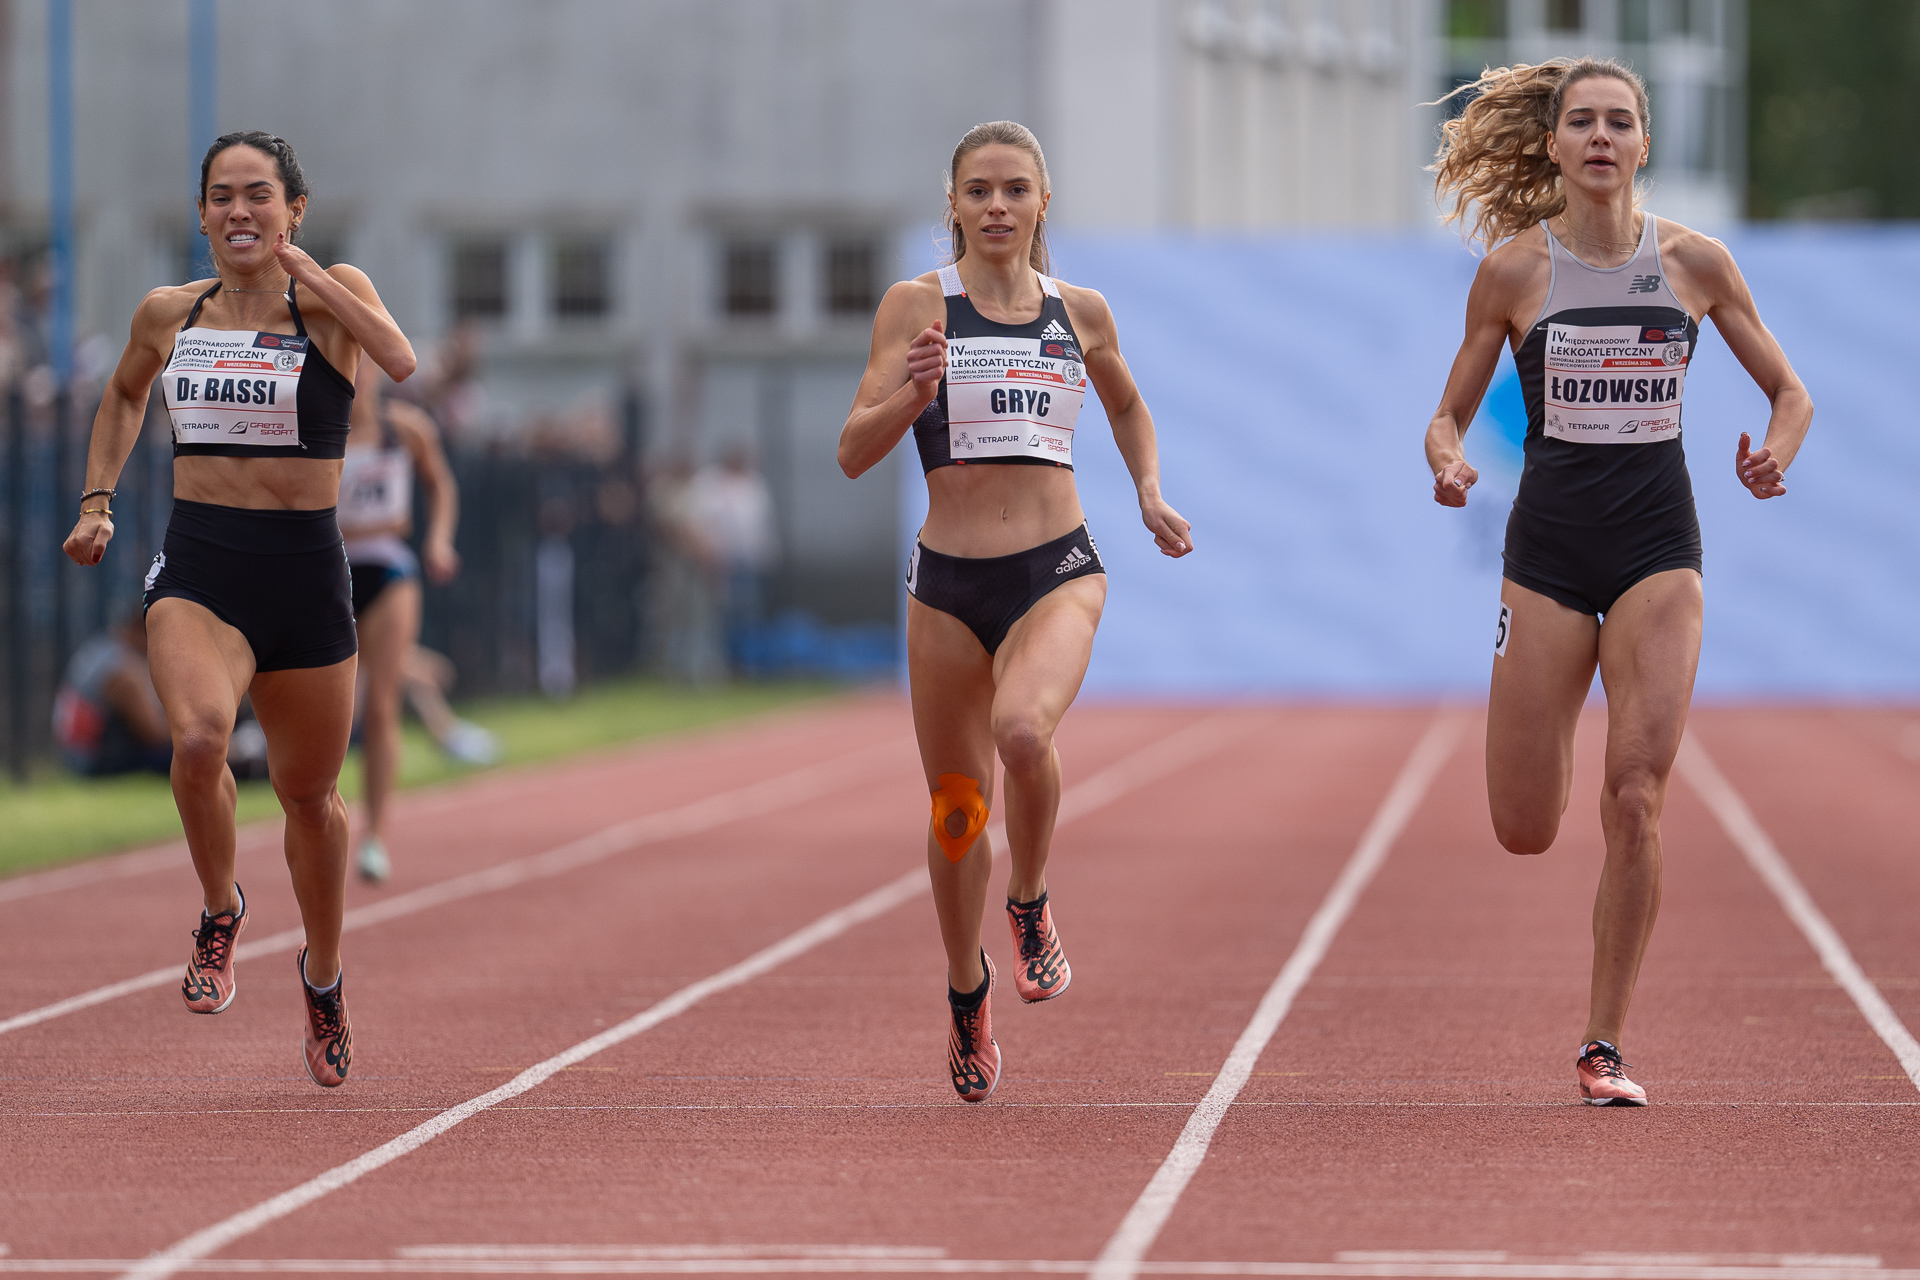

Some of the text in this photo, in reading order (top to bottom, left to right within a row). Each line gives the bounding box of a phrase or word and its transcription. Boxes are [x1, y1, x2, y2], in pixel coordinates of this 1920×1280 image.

[1041, 332, 1073, 341] adidas
[1552, 331, 1567, 342] IV
[950, 345, 1032, 357] IV MIĘDZYNARODOWY
[1550, 346, 1655, 357] LEKKOATLETYCZNY
[951, 358, 1056, 371] LEKKOATLETYCZNY
[204, 378, 277, 405] BASSI
[1551, 376, 1677, 403] ŁOZOWSKA
[990, 388, 1051, 417] GRYC
[1567, 422, 1610, 430] TETRAPUR
[1650, 423, 1677, 432] SPORT
[977, 435, 1019, 444] TETRAPUR
[1047, 444, 1070, 454] SPORT
[1055, 554, 1092, 575] adidas
[1496, 607, 1508, 649] 5
